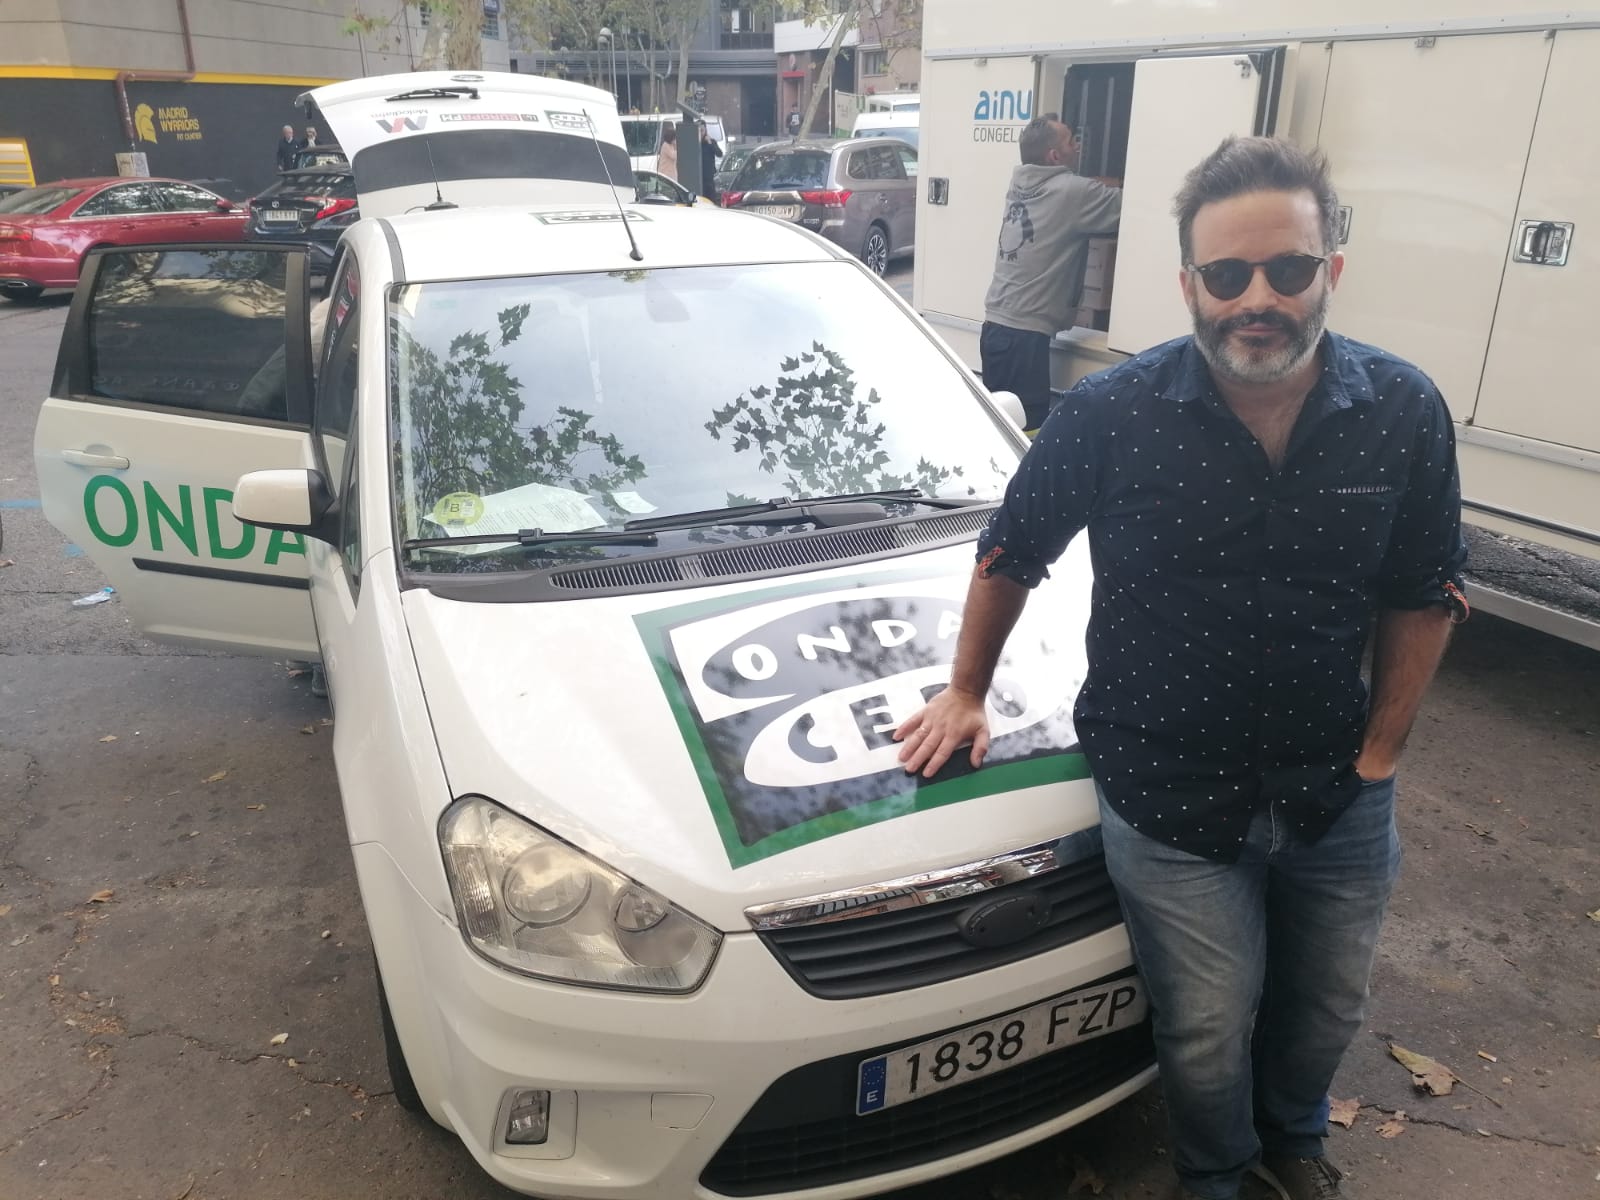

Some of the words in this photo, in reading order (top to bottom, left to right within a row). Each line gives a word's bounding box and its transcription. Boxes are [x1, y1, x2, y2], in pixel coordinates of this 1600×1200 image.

[158, 107, 188, 119] MADRID
[973, 127, 1025, 142] CONGEL
[787, 679, 1028, 763] CEO
[907, 1020, 1026, 1094] 1838
[1047, 986, 1137, 1045] FZP
[866, 1090, 878, 1104] E
